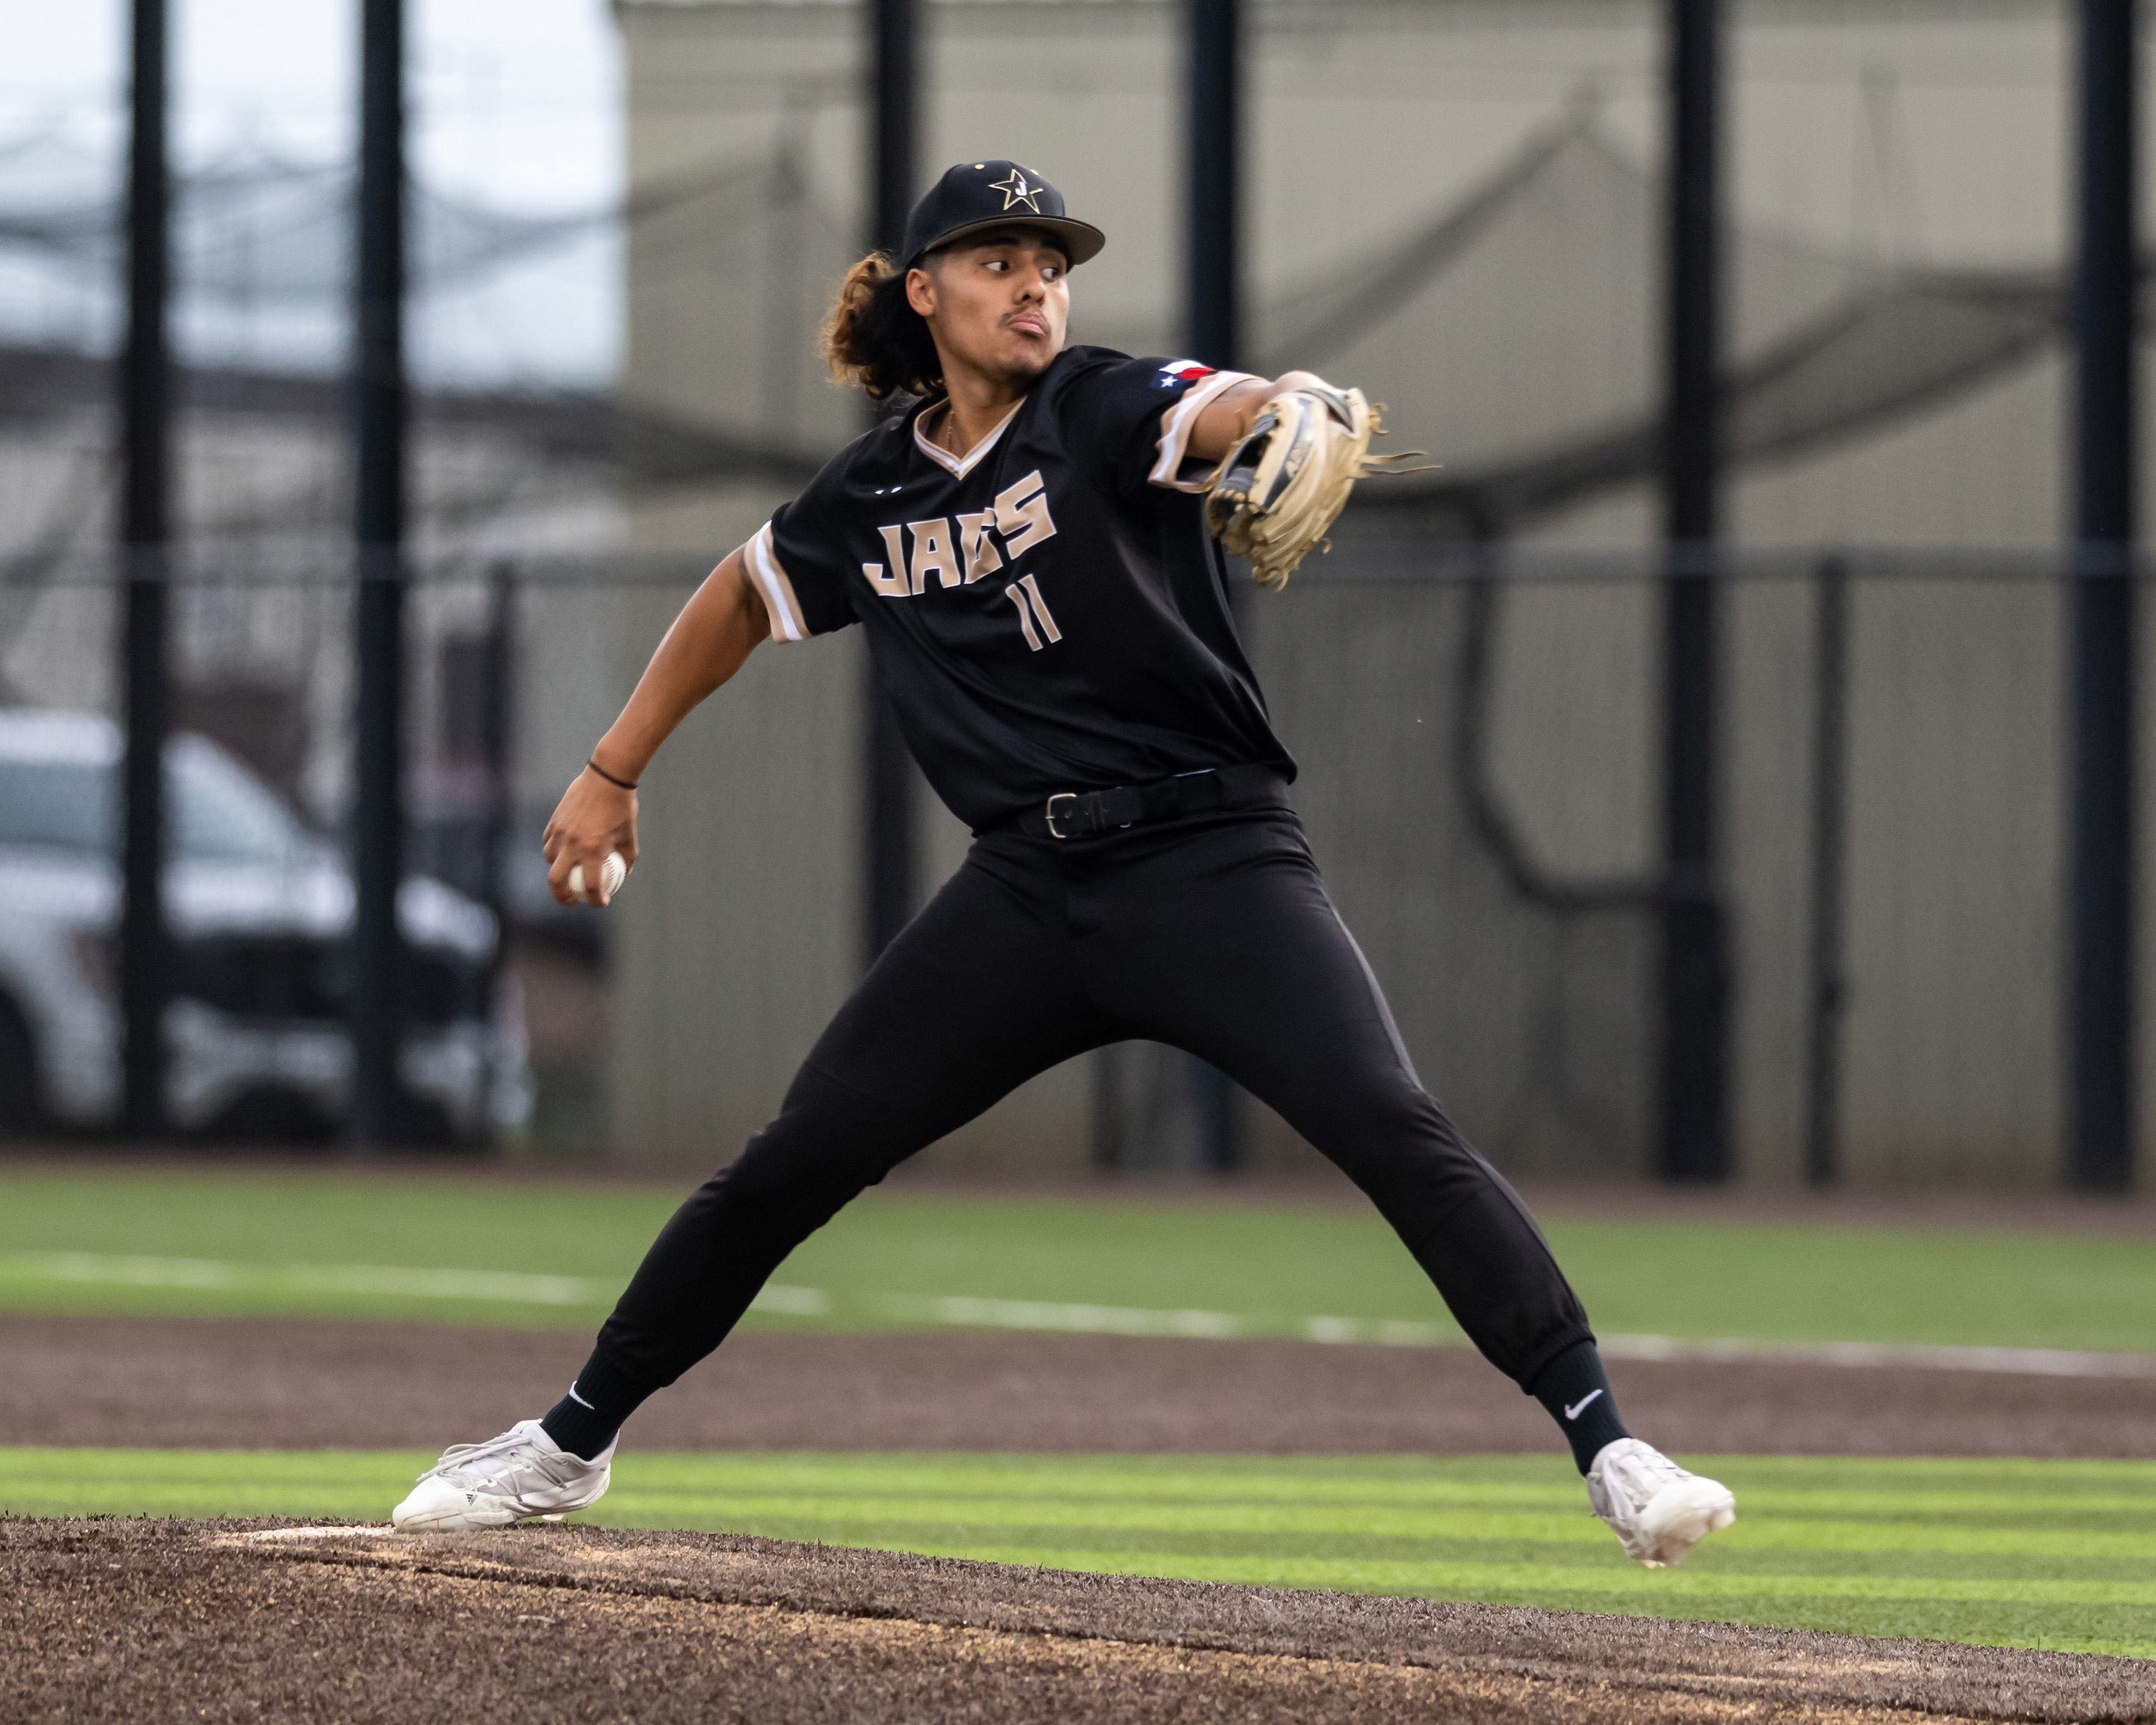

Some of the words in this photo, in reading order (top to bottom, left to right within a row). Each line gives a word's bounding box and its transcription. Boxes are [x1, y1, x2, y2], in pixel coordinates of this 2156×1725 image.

[1015, 181, 1027, 196] J
[862, 470, 1057, 597] JAGS
[1005, 573, 1062, 652] 11
